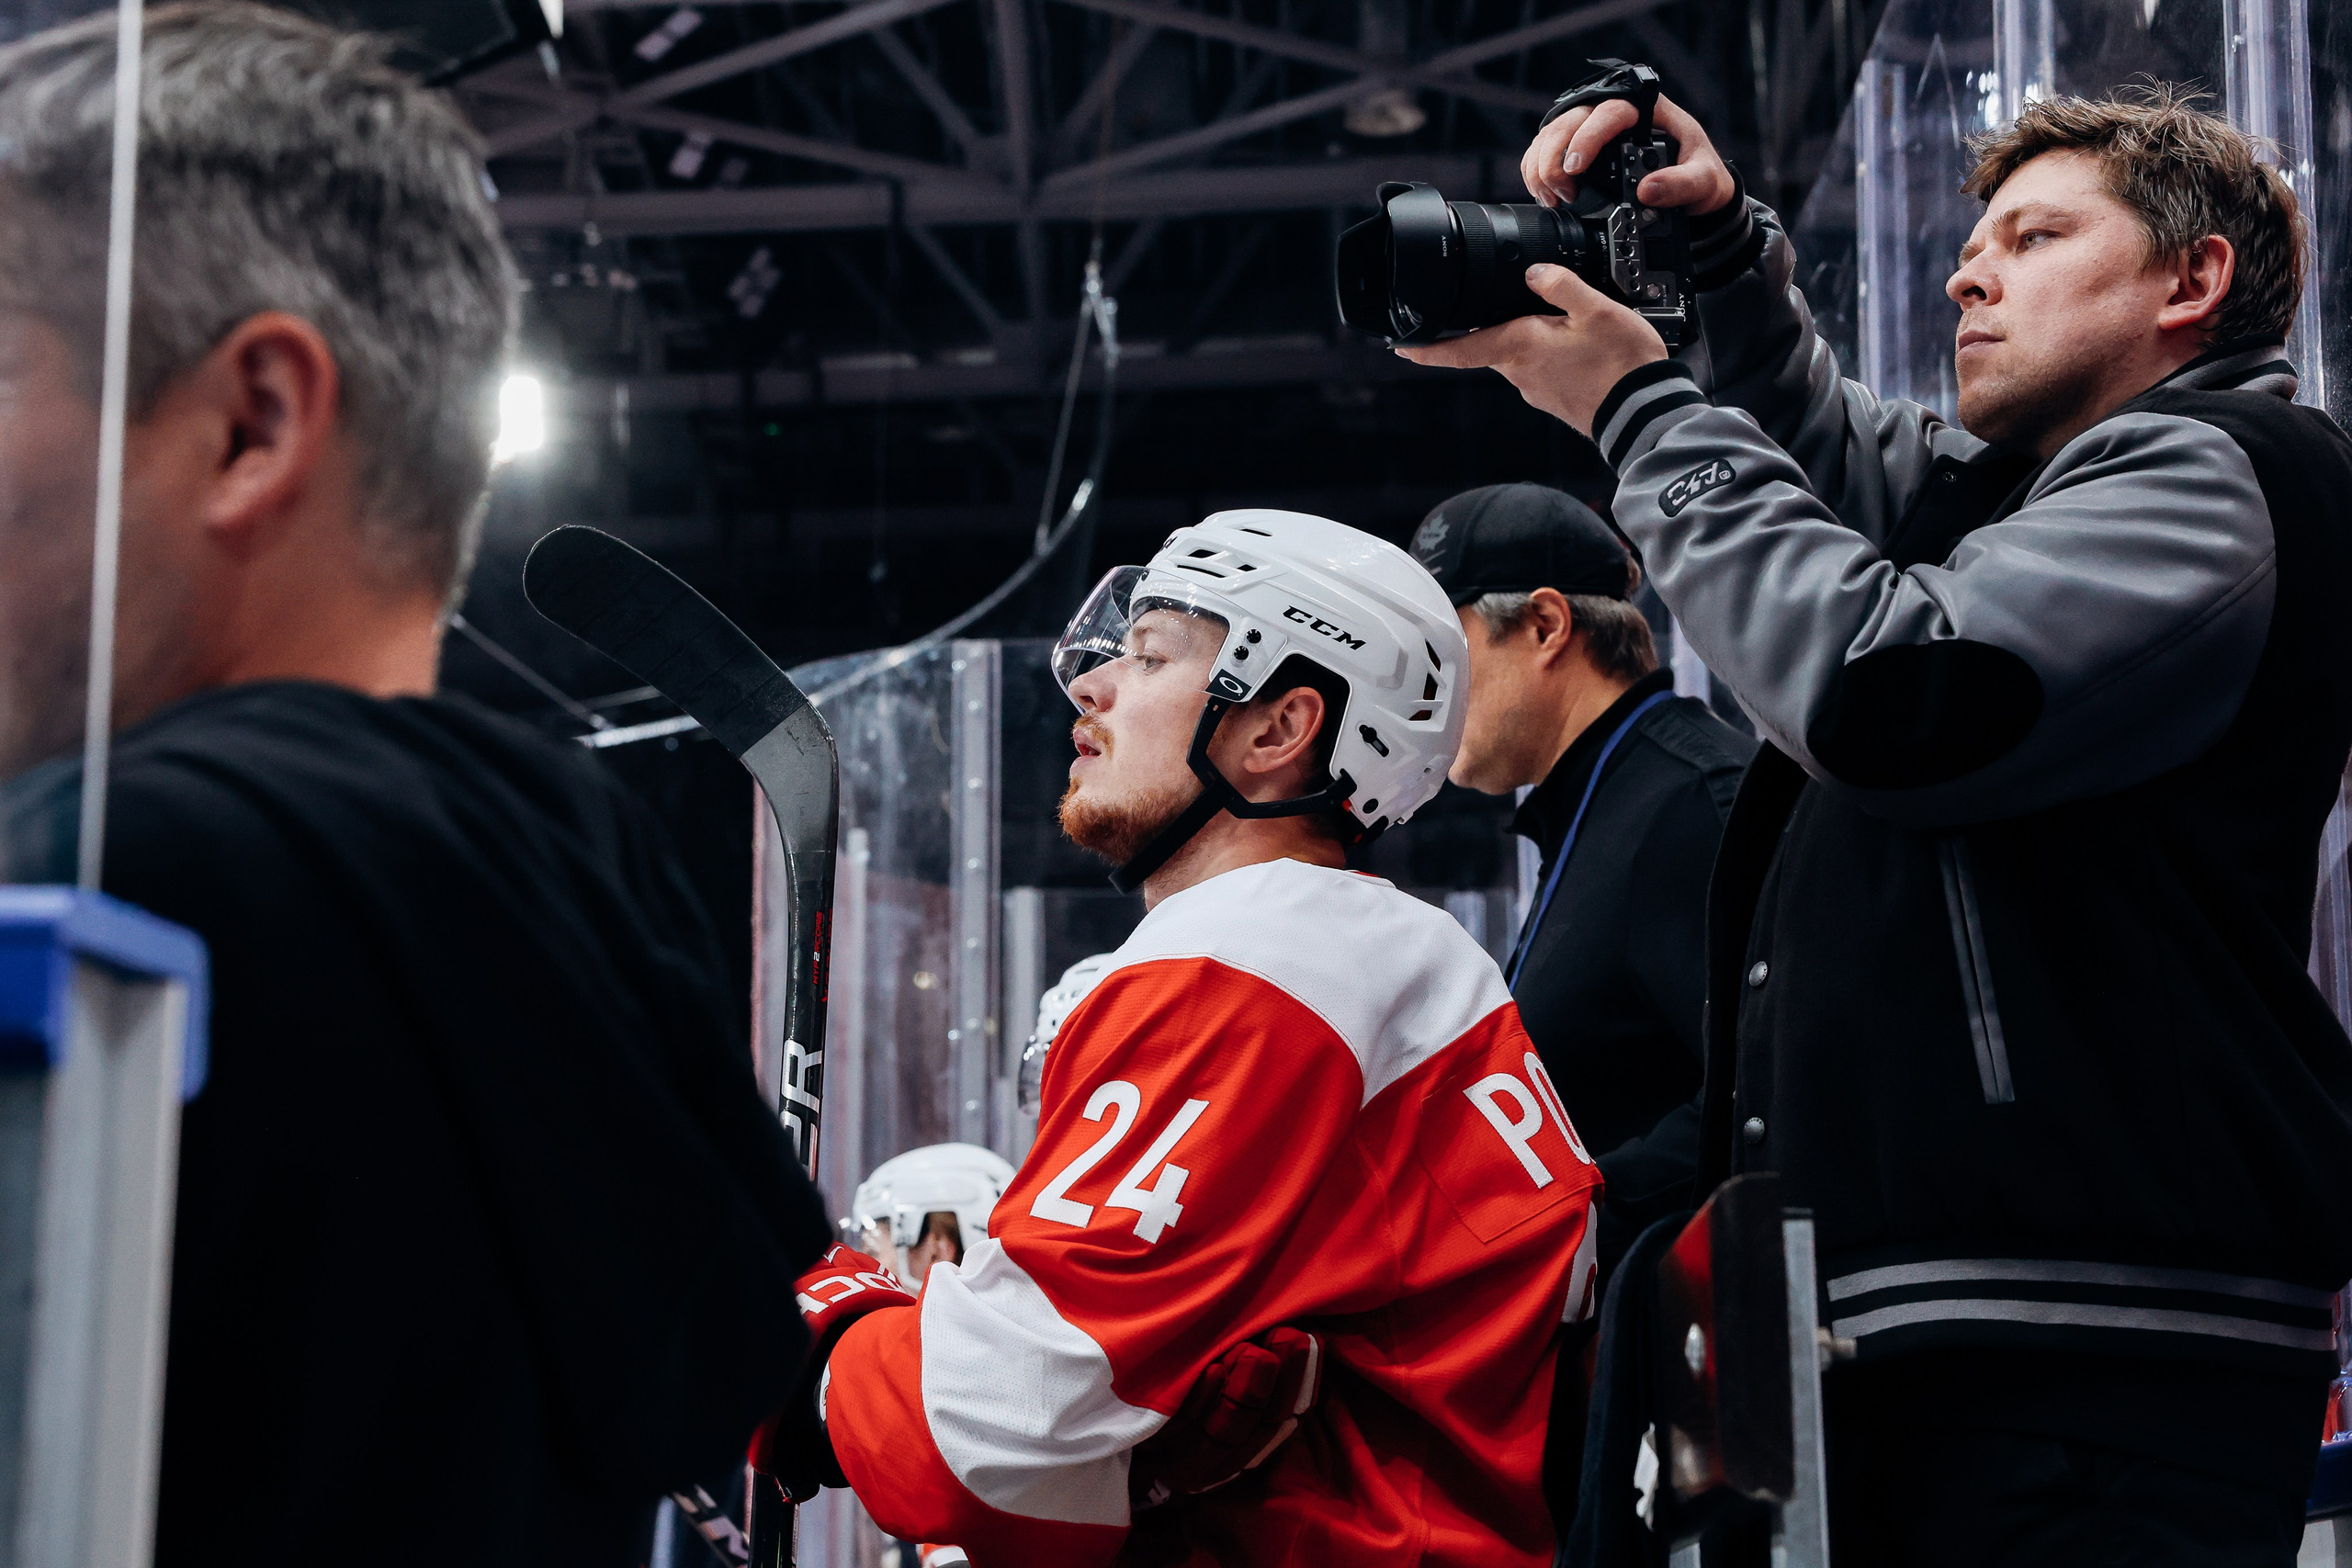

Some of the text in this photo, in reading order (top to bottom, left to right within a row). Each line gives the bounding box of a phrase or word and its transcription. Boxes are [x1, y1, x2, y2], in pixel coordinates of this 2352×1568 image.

[1679, 292, 1687, 322] ONY
[1283, 605, 1366, 650] CCM
[1029, 1080, 1210, 1244] 24
